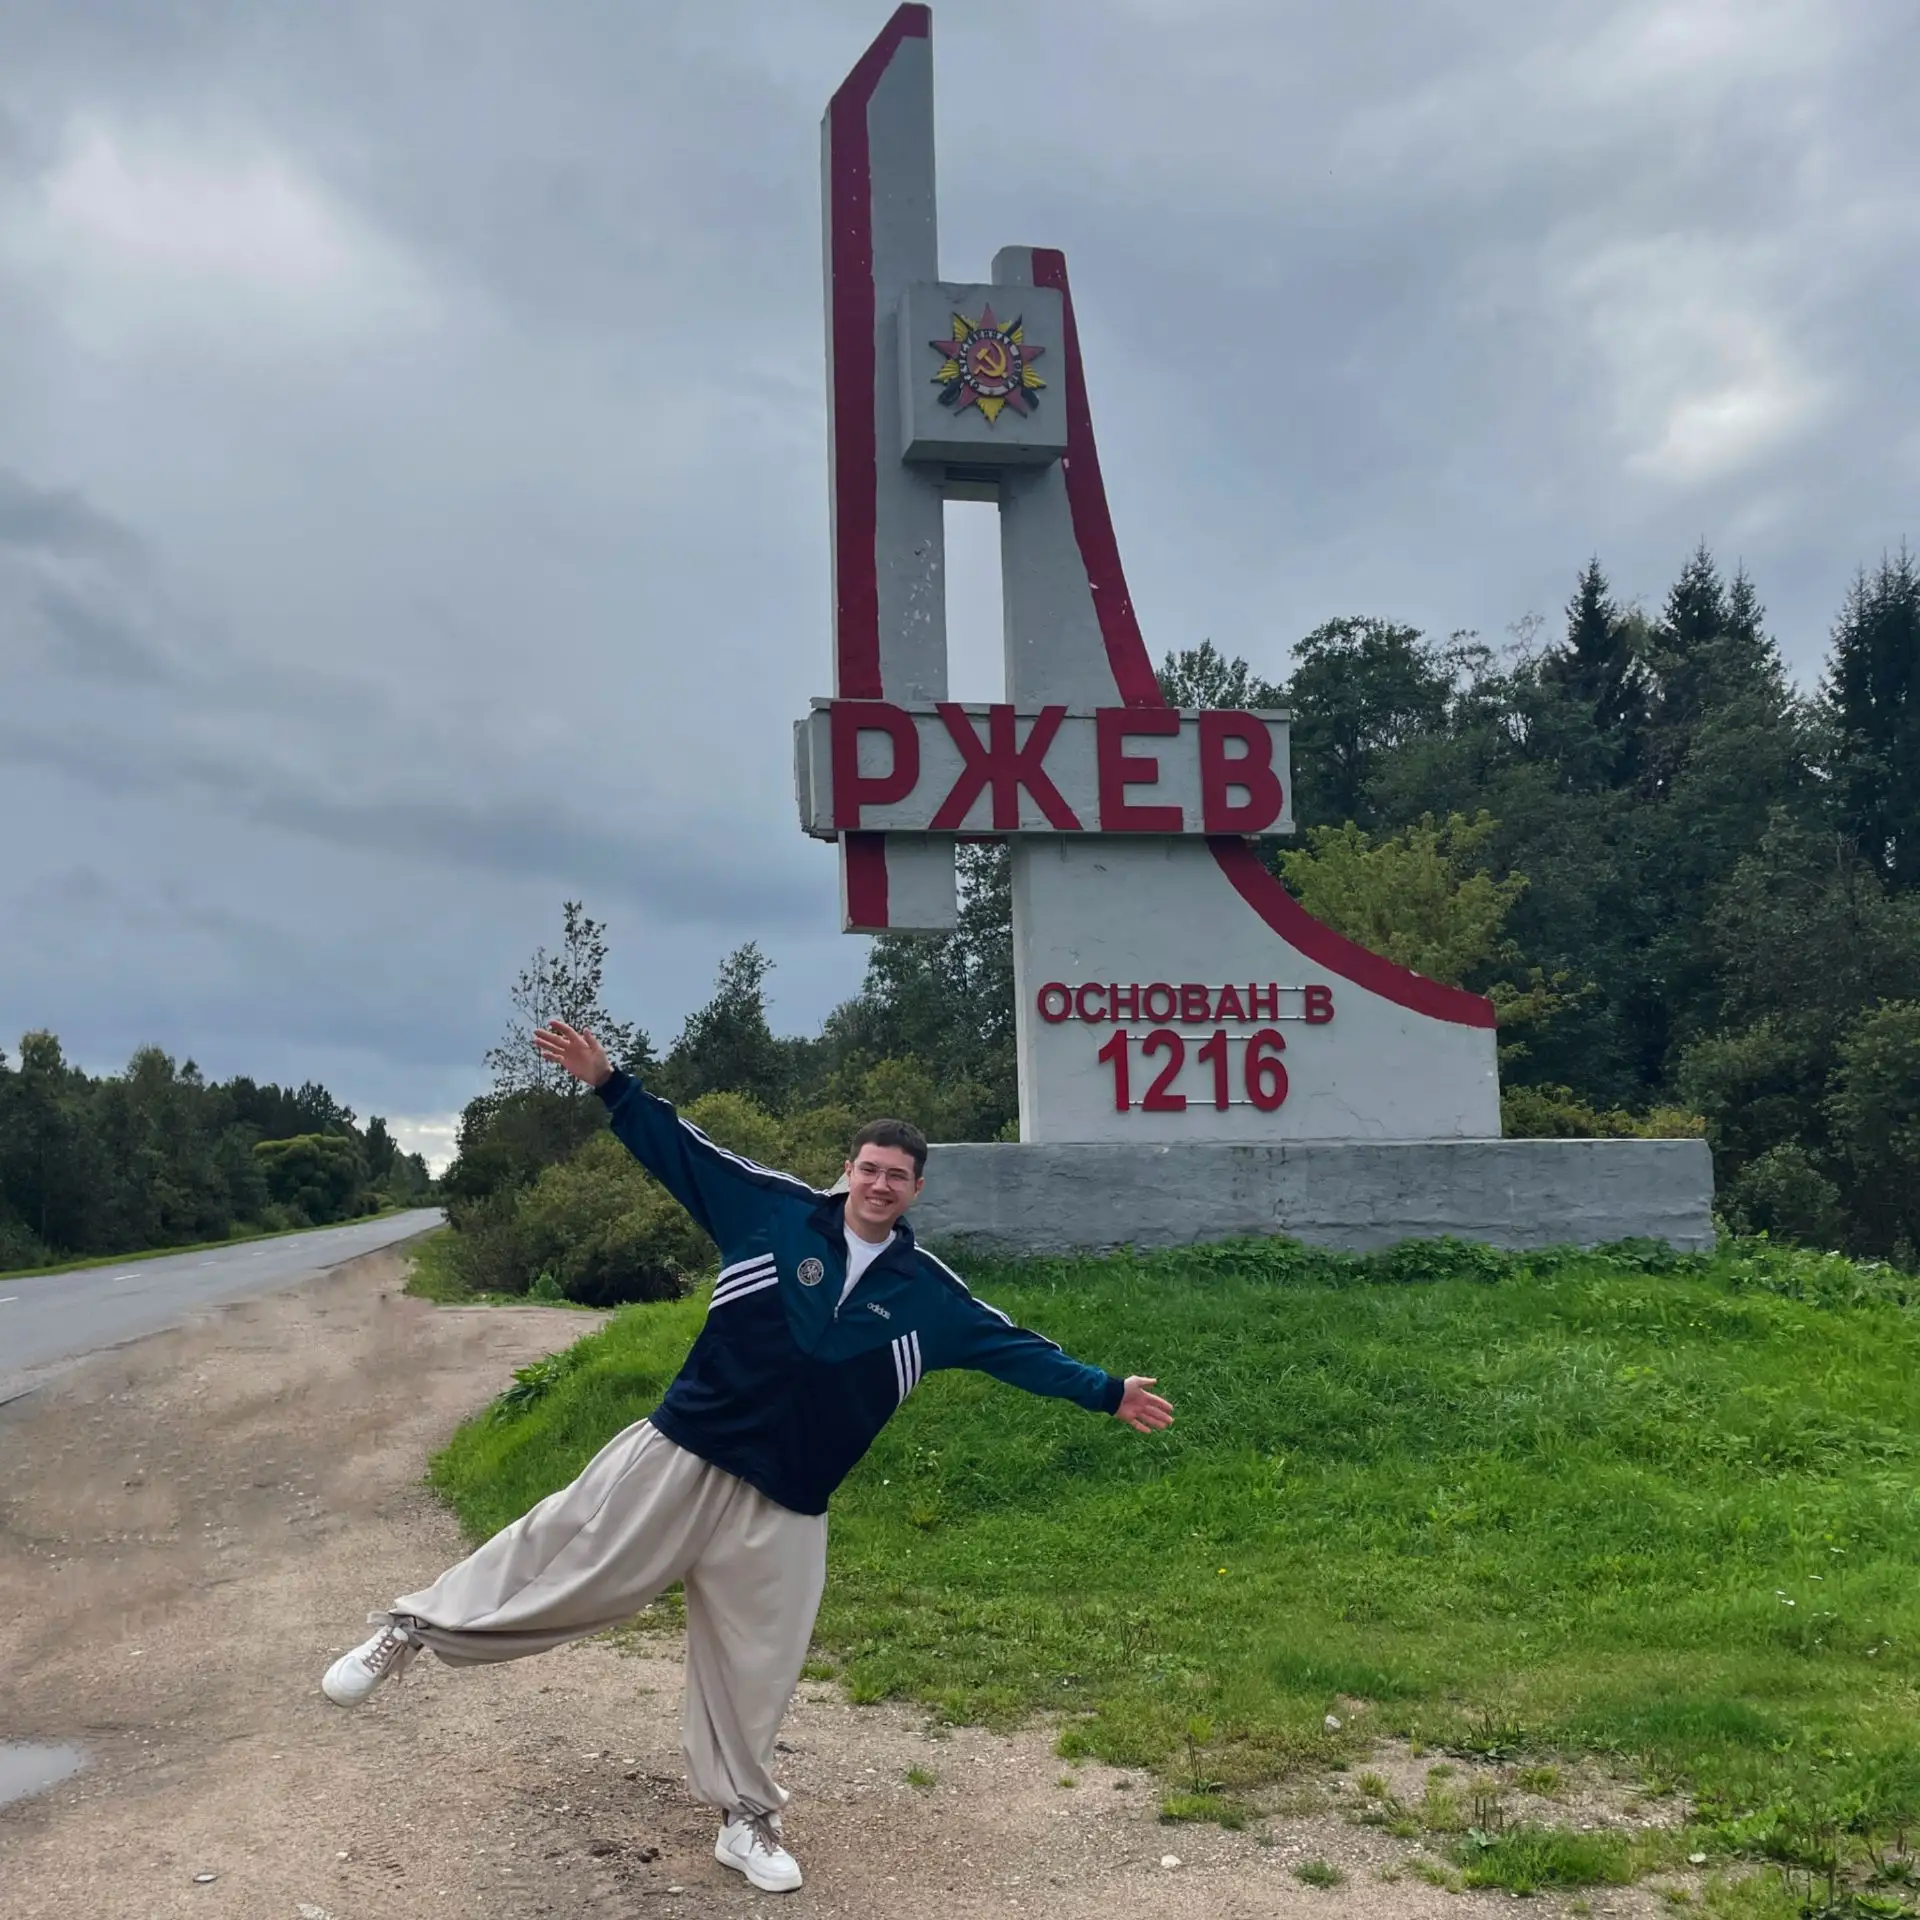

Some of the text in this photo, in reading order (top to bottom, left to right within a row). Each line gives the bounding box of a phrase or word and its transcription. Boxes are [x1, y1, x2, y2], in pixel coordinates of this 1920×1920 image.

[831, 702, 1283, 833] РЖЕВ
[1037, 982, 1336, 1025] ОСНОВАН В
[1098, 1028, 1289, 1112] 1216
[867, 1302, 891, 1319] adidas
